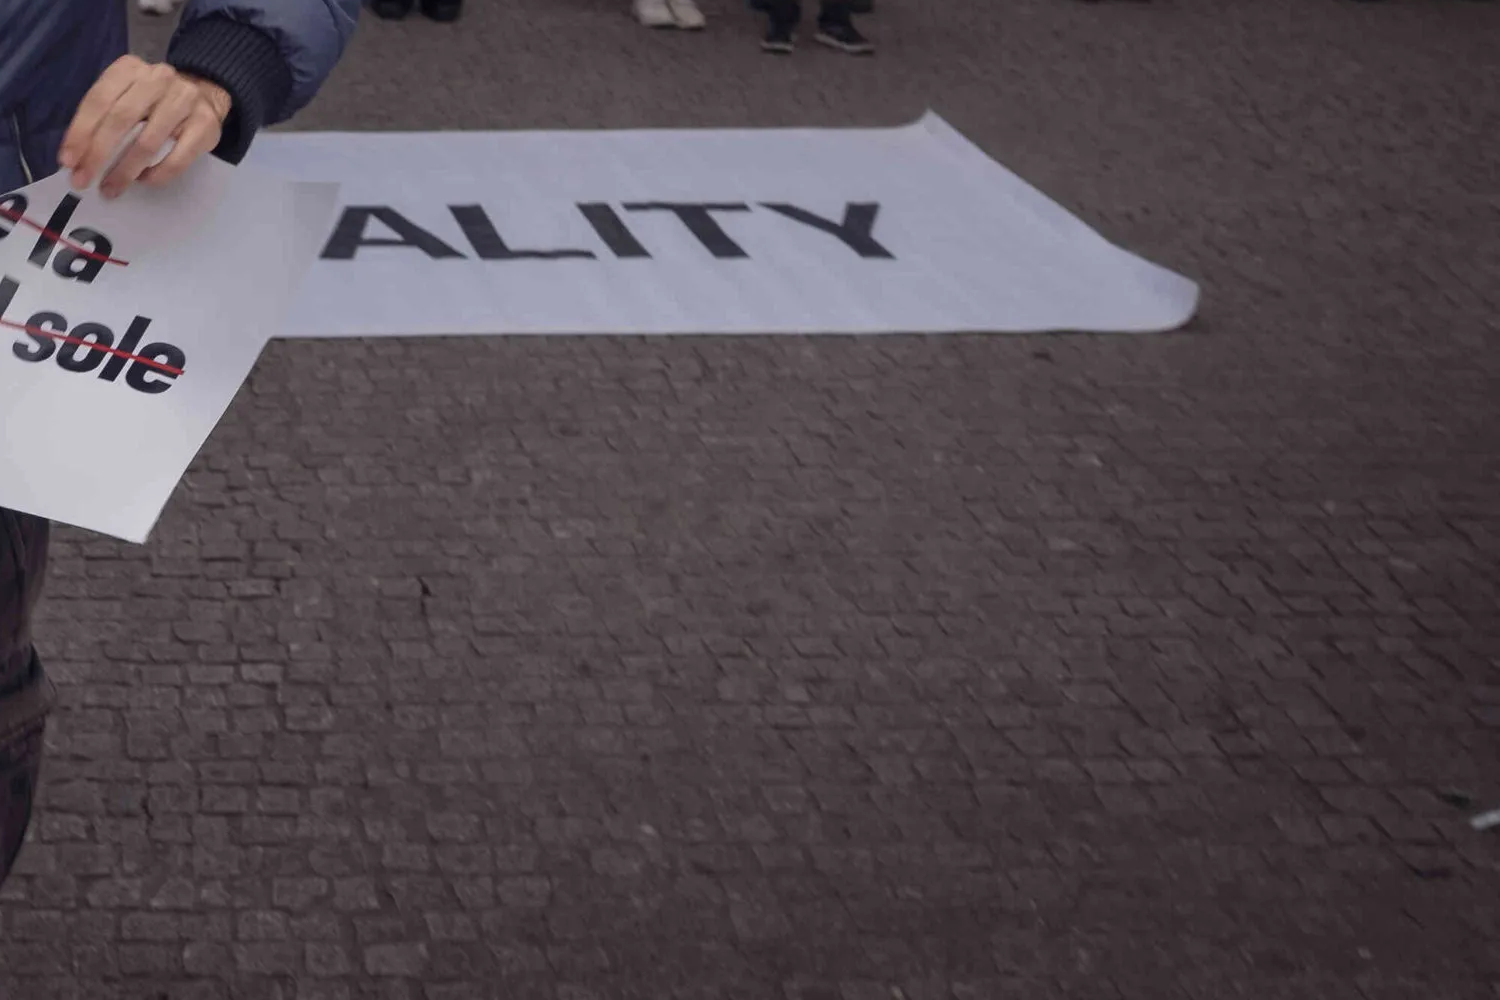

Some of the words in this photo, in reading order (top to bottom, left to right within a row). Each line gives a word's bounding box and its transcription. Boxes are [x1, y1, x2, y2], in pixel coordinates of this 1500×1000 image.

[26, 191, 113, 284] la
[319, 201, 896, 261] ALITY
[11, 314, 187, 394] sole
